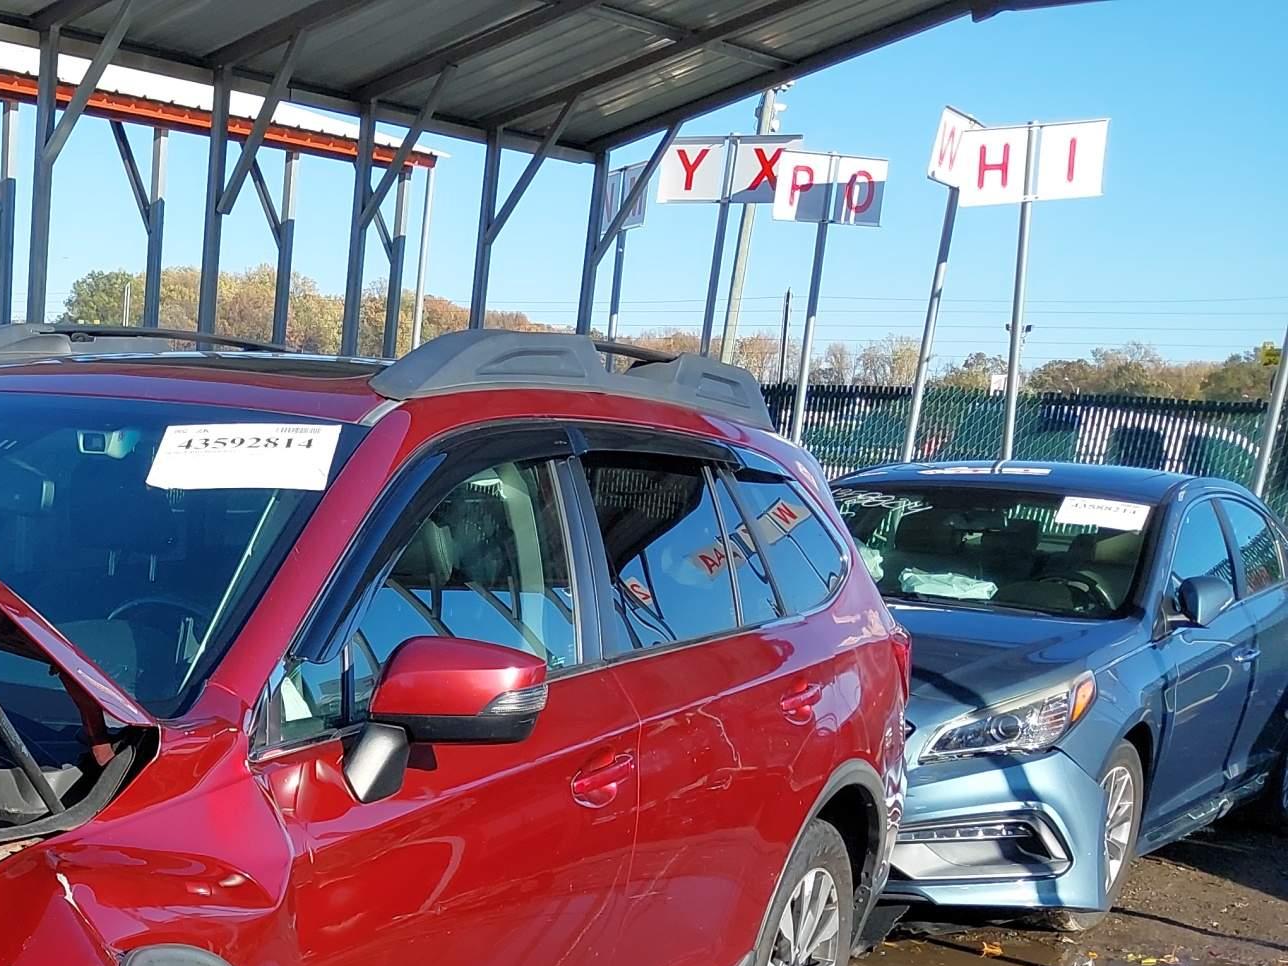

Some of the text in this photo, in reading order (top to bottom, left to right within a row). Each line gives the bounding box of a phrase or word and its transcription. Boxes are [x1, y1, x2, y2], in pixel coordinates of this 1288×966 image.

[677, 148, 785, 190] Y X
[977, 137, 1077, 190] H I
[790, 165, 814, 206] P
[177, 437, 314, 450] 43592814
